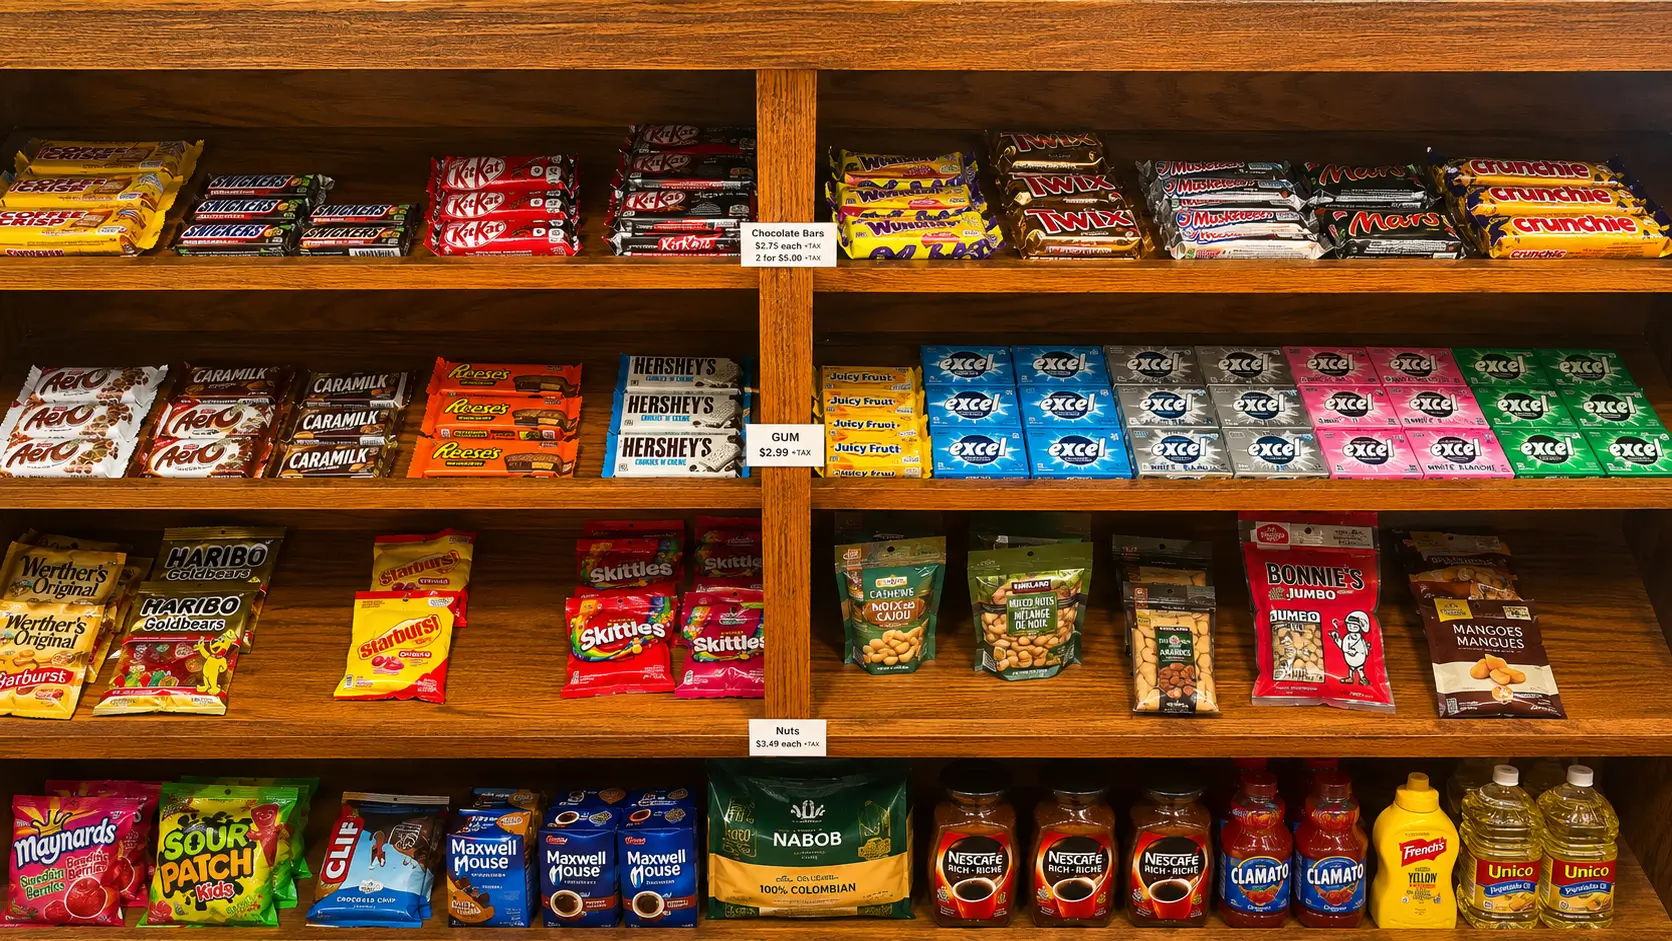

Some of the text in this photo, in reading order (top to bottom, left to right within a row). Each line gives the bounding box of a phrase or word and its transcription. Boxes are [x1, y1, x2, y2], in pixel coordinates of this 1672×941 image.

[451, 156, 500, 188] KitKat
[1319, 164, 1406, 186] Mars
[198, 200, 279, 214] SNICKERS
[451, 192, 501, 217] KitKat
[184, 224, 266, 238] SNICKERS
[1348, 210, 1440, 236] Mars
[452, 220, 503, 245] KitKat
[752, 229, 824, 238] Chocolate Bars
[755, 242, 778, 250] $2.75
[778, 254, 802, 262] $5.00
[634, 357, 716, 375] HERSHEY'S
[940, 354, 994, 371] excel
[1032, 354, 1086, 371] excel
[1126, 354, 1180, 371] excel
[1218, 354, 1270, 371] excel
[1306, 354, 1354, 371] excel
[1389, 355, 1438, 371] excel
[1474, 356, 1526, 373] excel
[1559, 356, 1610, 374] excel
[193, 368, 269, 382] CARAMILK
[448, 364, 510, 380] Reese's
[314, 374, 389, 393] CARAMILK
[444, 398, 510, 414] Reese's
[628, 396, 714, 414] HERSHEY'S
[830, 396, 862, 405] Juicy
[944, 394, 1000, 412] excel
[1040, 394, 1096, 412] excel
[1138, 394, 1193, 412] excel
[1232, 394, 1285, 412] excel
[1324, 394, 1375, 412] excel
[1408, 394, 1460, 412] excel
[1496, 395, 1550, 412] excel
[1583, 396, 1636, 414] excel
[23, 404, 94, 432] Aero
[172, 406, 243, 434] Aero
[302, 410, 379, 430] CARAMILK
[833, 420, 864, 429] Juicy
[772, 432, 800, 442] GUM
[6, 440, 79, 468] Aero
[432, 442, 502, 460] Reese's
[622, 437, 712, 458] HERSHEY'S
[759, 448, 788, 457] $2.99
[835, 443, 866, 454] Juicy
[948, 438, 1008, 457] excel
[1048, 438, 1106, 457] excel
[1151, 438, 1207, 456] excel
[1248, 438, 1300, 456] excel
[1342, 438, 1395, 458] excel
[1430, 438, 1482, 458] excel
[1520, 438, 1574, 456] excel
[1608, 438, 1663, 457] excel
[154, 444, 226, 470] Aero
[289, 448, 370, 469] CARAMILK
[165, 543, 268, 570] HARIBO
[704, 555, 762, 570] Skittle
[20, 555, 108, 584] Werther's
[166, 568, 250, 581] Goldbears
[380, 550, 460, 586] Starburst
[590, 562, 673, 582] Skittles
[1266, 562, 1364, 590] BONNIE'S
[32, 577, 98, 600] Original
[1287, 588, 1336, 600] JUMBO
[140, 596, 241, 617] HARIBO
[4, 614, 88, 635] Werther's
[143, 616, 226, 632] Goldbears
[1452, 624, 1523, 638] MANGOES
[14, 630, 78, 650] Original
[360, 616, 440, 659] Starburst
[580, 620, 666, 652] Skittles
[1456, 636, 1525, 649] MANGUES
[776, 727, 800, 735] Nuts
[14, 818, 116, 864] Maynards
[164, 823, 249, 860] SOUR
[451, 838, 517, 856] Maxwell
[773, 832, 842, 848] NABOB
[326, 822, 358, 879] CLIF
[547, 850, 606, 865] Maxwell
[627, 849, 686, 865] Maxwell
[1403, 840, 1445, 860] French's
[161, 848, 252, 894] PATCH
[948, 864, 1002, 874] RICH RICHE
[1048, 864, 1102, 873] RICH RICHE
[1144, 865, 1199, 875] RICH RICHE
[1231, 862, 1289, 884] CLAMATO
[1307, 863, 1364, 885] CLAMATO
[1488, 864, 1534, 879] Unico
[1564, 864, 1609, 879] Unico
[1408, 872, 1438, 884] YELLOW
[195, 880, 236, 902] Kids
[760, 883, 856, 895] 100% COLOMBIAN
